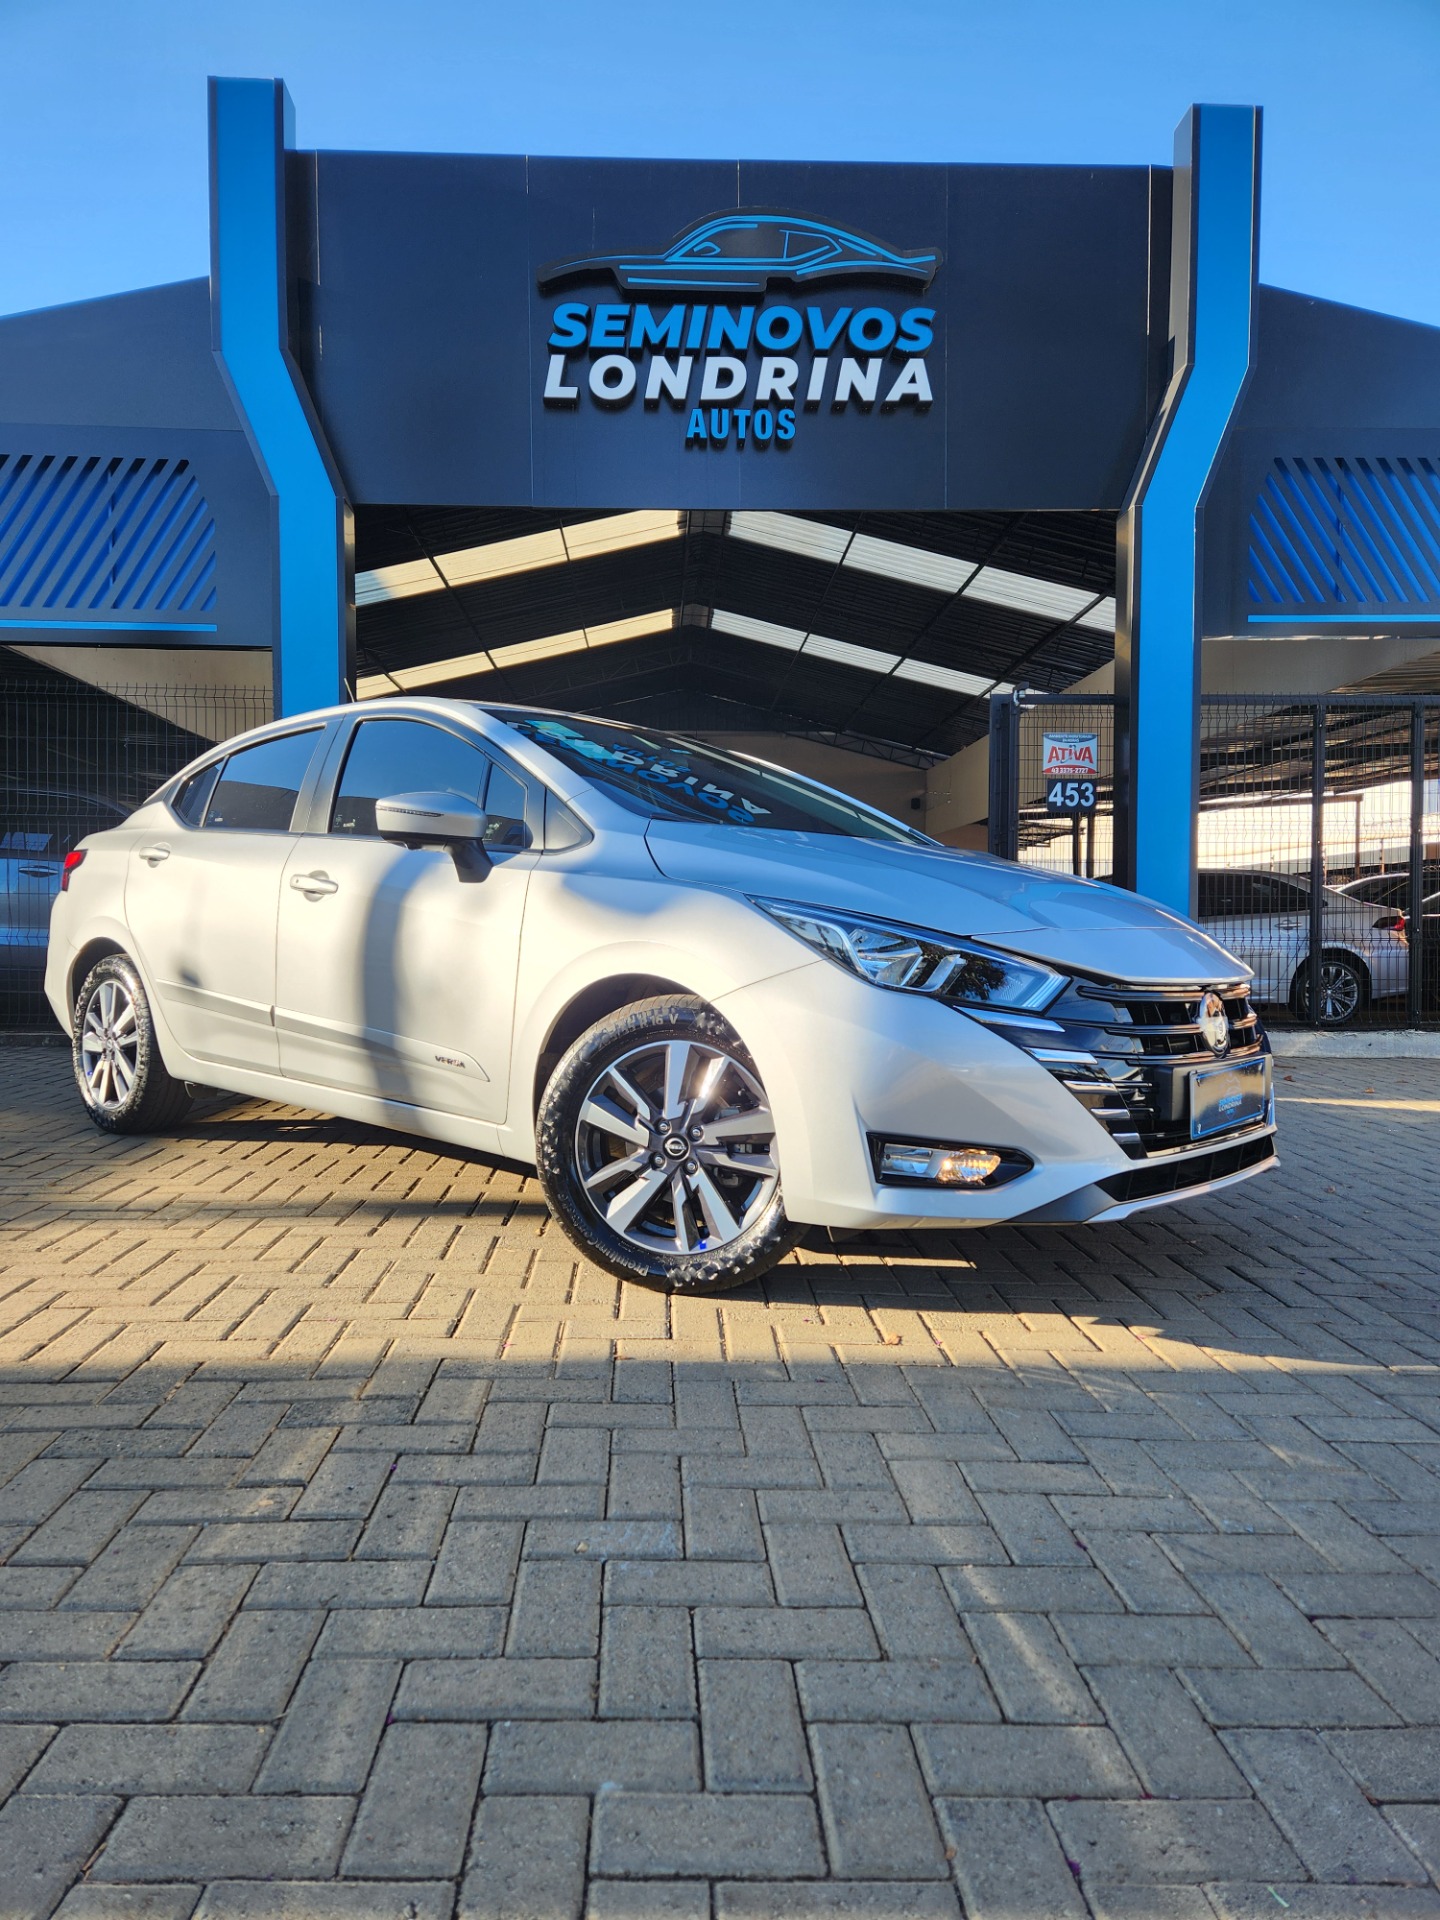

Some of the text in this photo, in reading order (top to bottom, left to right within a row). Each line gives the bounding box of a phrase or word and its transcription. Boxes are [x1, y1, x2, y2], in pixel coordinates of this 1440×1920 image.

[547, 302, 937, 352] SEMINOVOS
[543, 354, 933, 402] LONDRINA
[686, 408, 797, 441] AUTOS
[1047, 745, 1094, 764] ATIVA
[1048, 782, 1095, 807] 453
